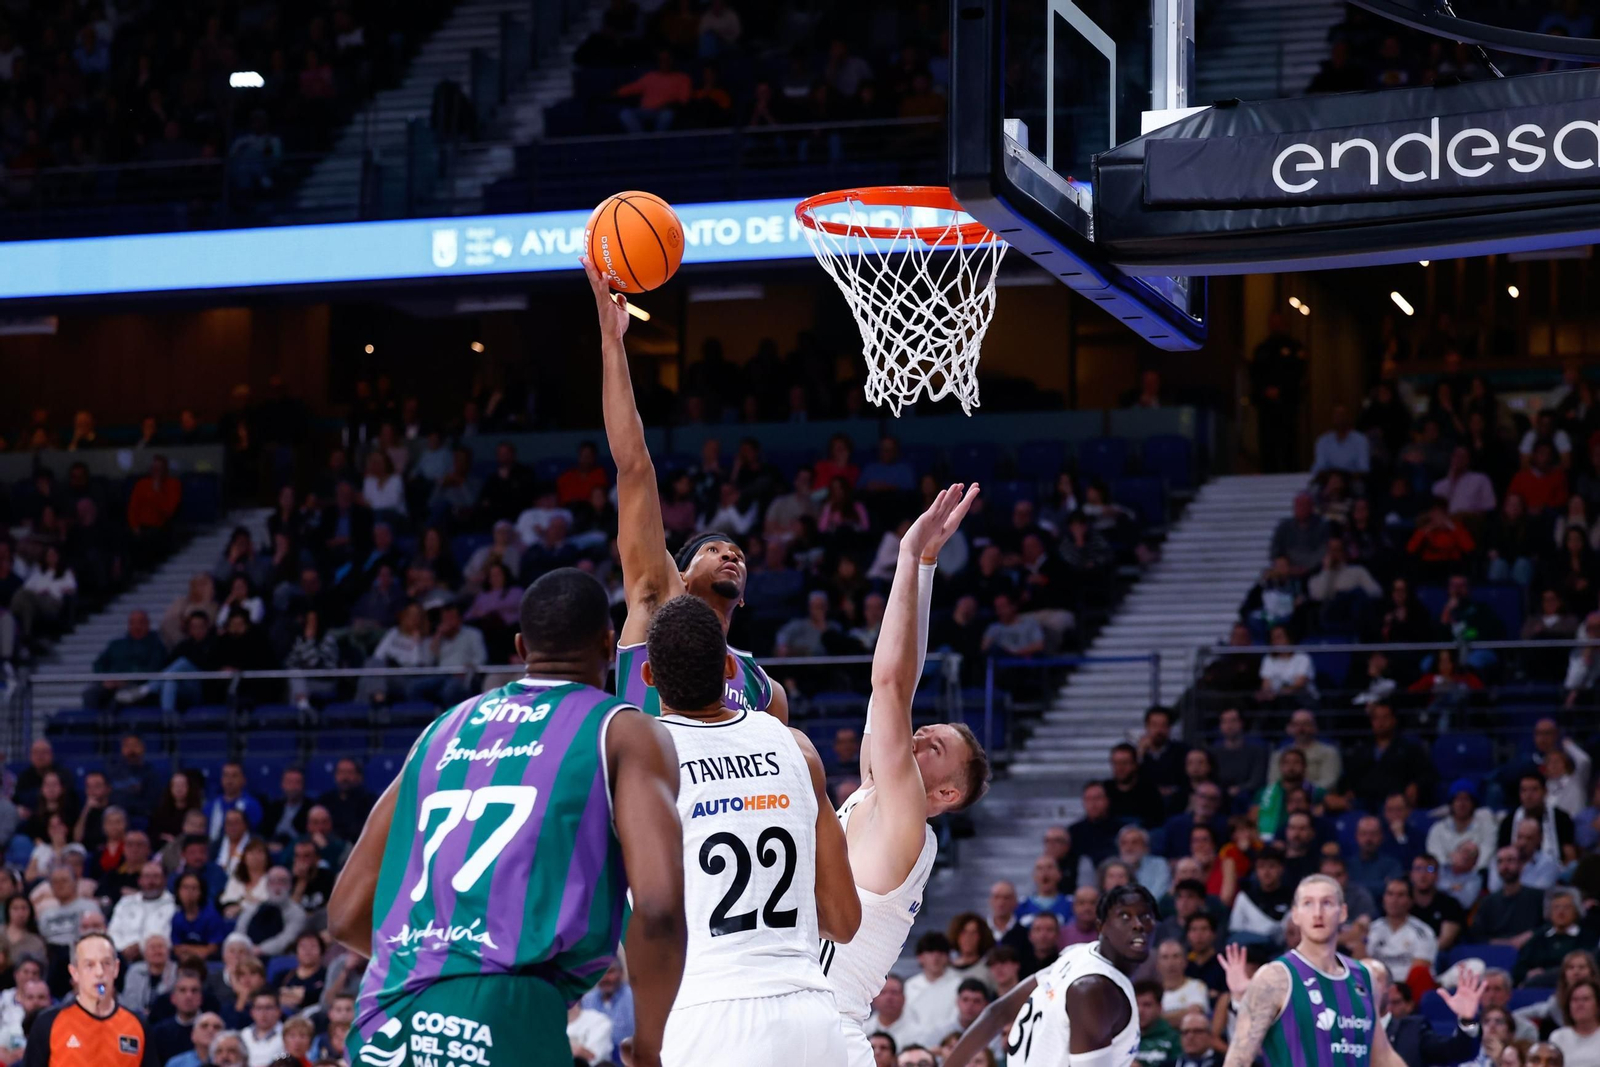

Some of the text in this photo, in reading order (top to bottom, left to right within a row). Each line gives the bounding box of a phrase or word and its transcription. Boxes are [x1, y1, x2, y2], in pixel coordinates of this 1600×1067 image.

[1272, 117, 1600, 193] endesa
[746, 215, 784, 244] DE
[601, 236, 617, 275] endesa
[470, 698, 551, 725] Sima
[680, 752, 780, 784] TAVARES
[691, 794, 790, 818] AUTOHERO
[410, 785, 538, 902] 77
[699, 826, 798, 937] 22
[412, 1011, 493, 1047] COSTA
[410, 1034, 491, 1067] DEL SOL
